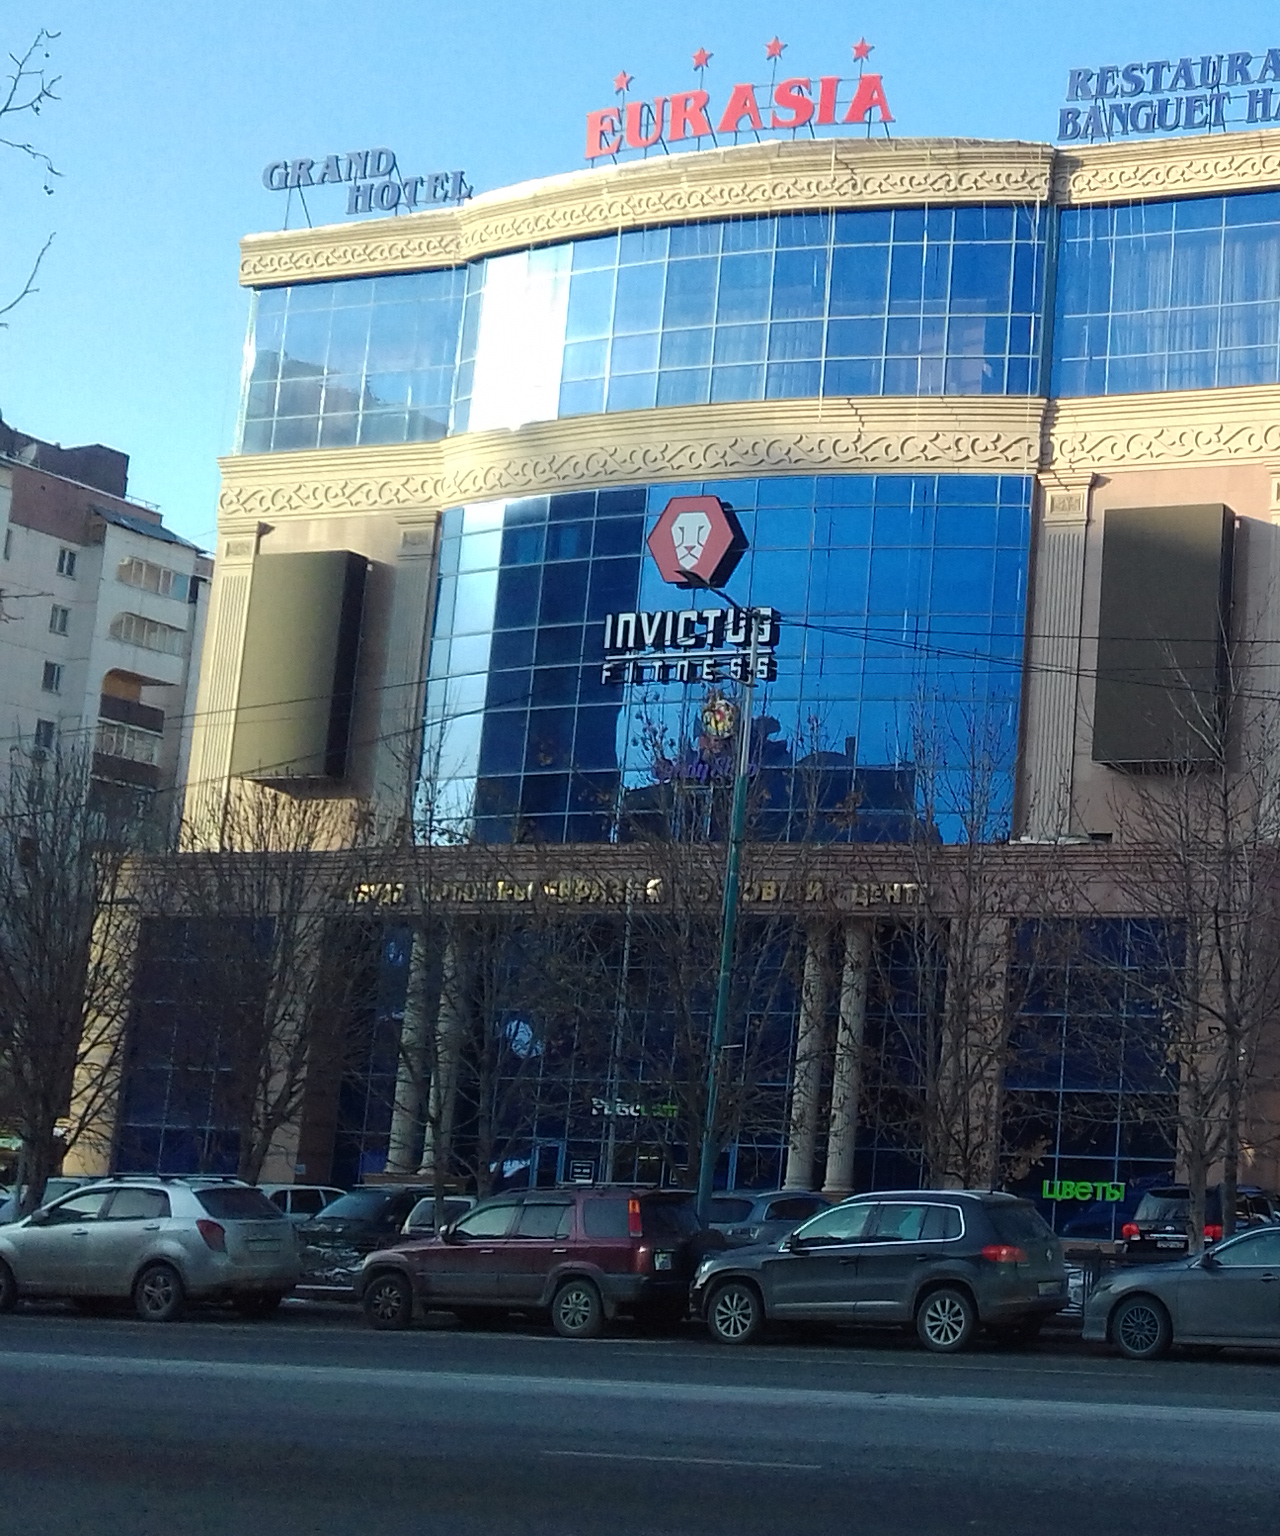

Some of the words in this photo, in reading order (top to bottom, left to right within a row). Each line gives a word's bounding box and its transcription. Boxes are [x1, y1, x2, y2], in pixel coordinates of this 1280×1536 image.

[585, 74, 897, 159] EURASIA
[261, 147, 396, 191] GRAND
[345, 170, 474, 215] HOTEL
[604, 607, 773, 649] INVICTUS
[601, 657, 770, 685] FITNESS
